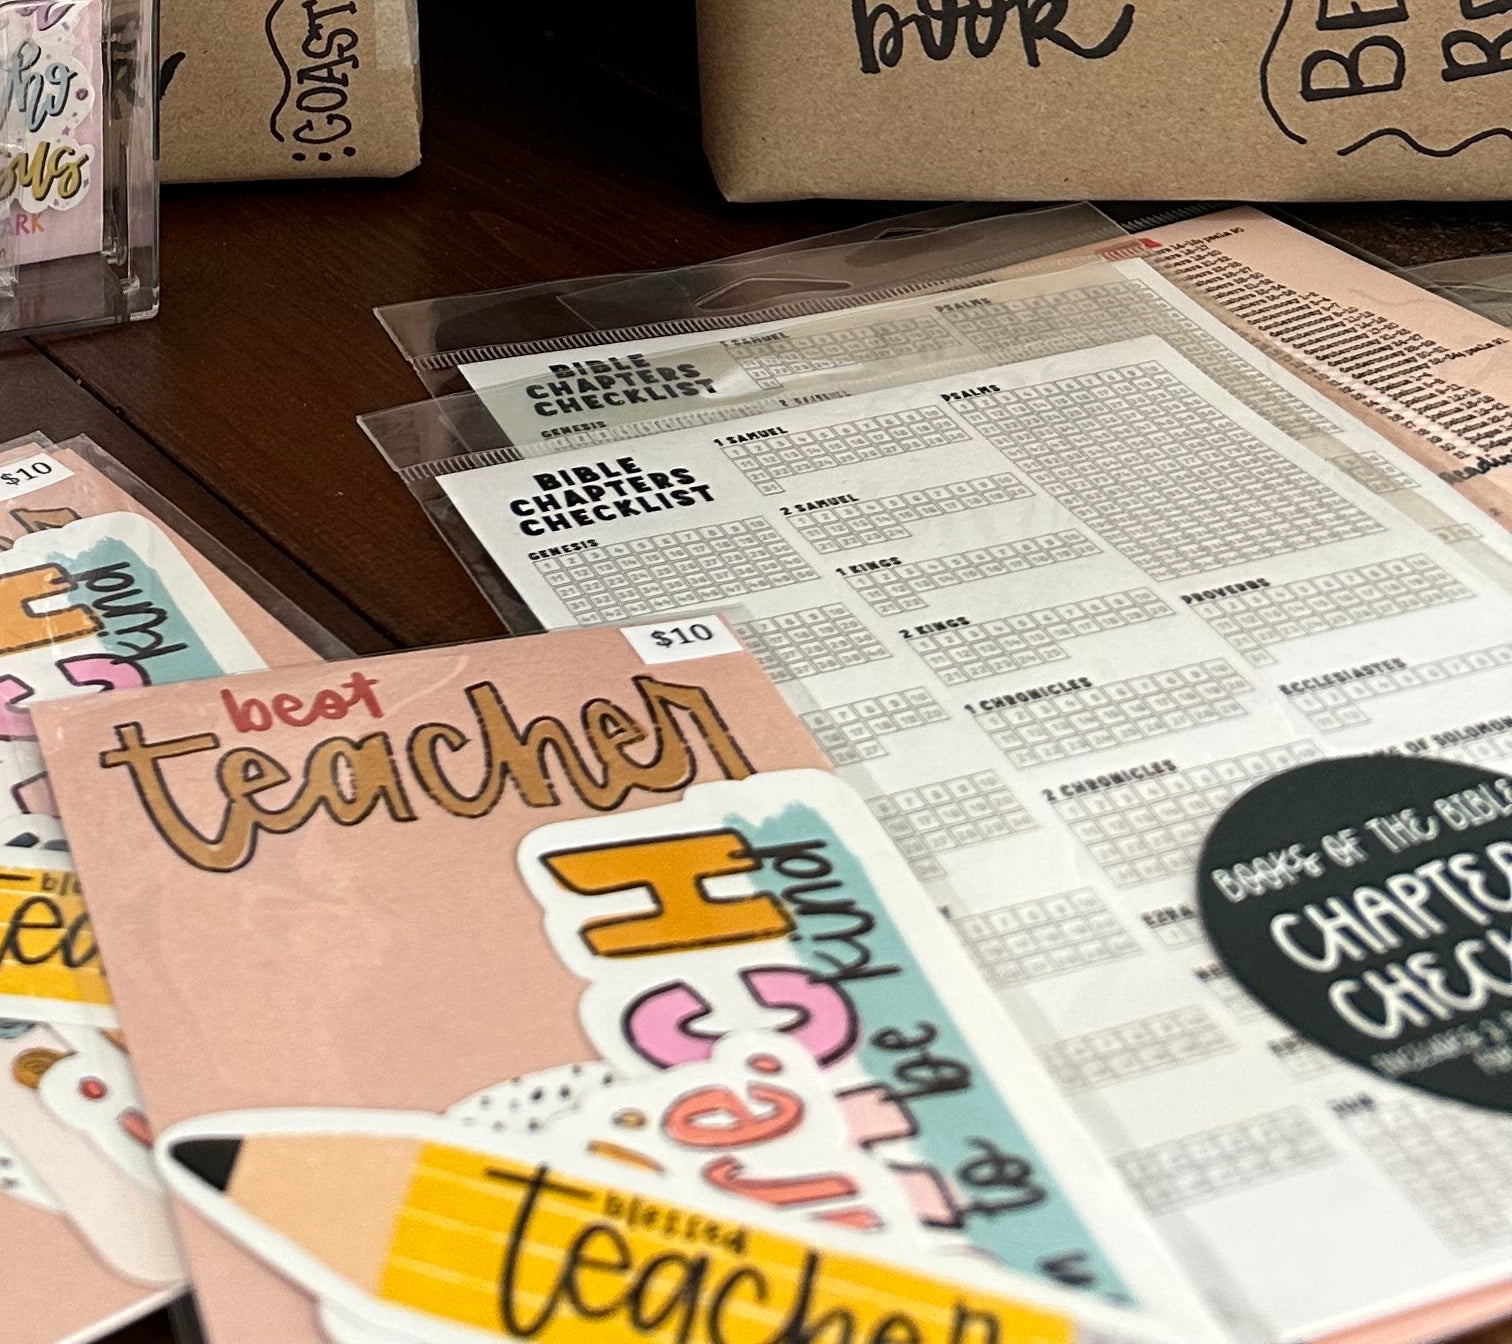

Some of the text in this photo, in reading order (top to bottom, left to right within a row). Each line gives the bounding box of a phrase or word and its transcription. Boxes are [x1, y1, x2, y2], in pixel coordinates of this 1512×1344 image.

[525, 363, 702, 400] CHAPTERS
[548, 353, 651, 378] BIBLE
[534, 378, 718, 417] CHECKLIST
[940, 384, 1001, 402] PSALMS
[728, 425, 790, 443] SAMUEL
[0, 460, 53, 487] $10
[533, 456, 643, 491] BIBLE
[510, 468, 696, 516] CHAPTERS
[794, 493, 859, 514] SAMUEL
[519, 484, 715, 536] CHECKLIST
[528, 539, 599, 561] GENESIS
[848, 556, 902, 575] KINGS
[1180, 577, 1271, 605] PROVERBS
[650, 622, 714, 649] $10
[914, 616, 971, 636] KINGS
[1277, 657, 1408, 696] ECCLESIASTES
[220, 672, 384, 733] best
[979, 677, 1093, 711] CHRONICLES
[101, 675, 756, 872] teacher
[1059, 759, 1177, 798] CHRONICLES
[1211, 808, 1439, 903] BOOKS OF THE
